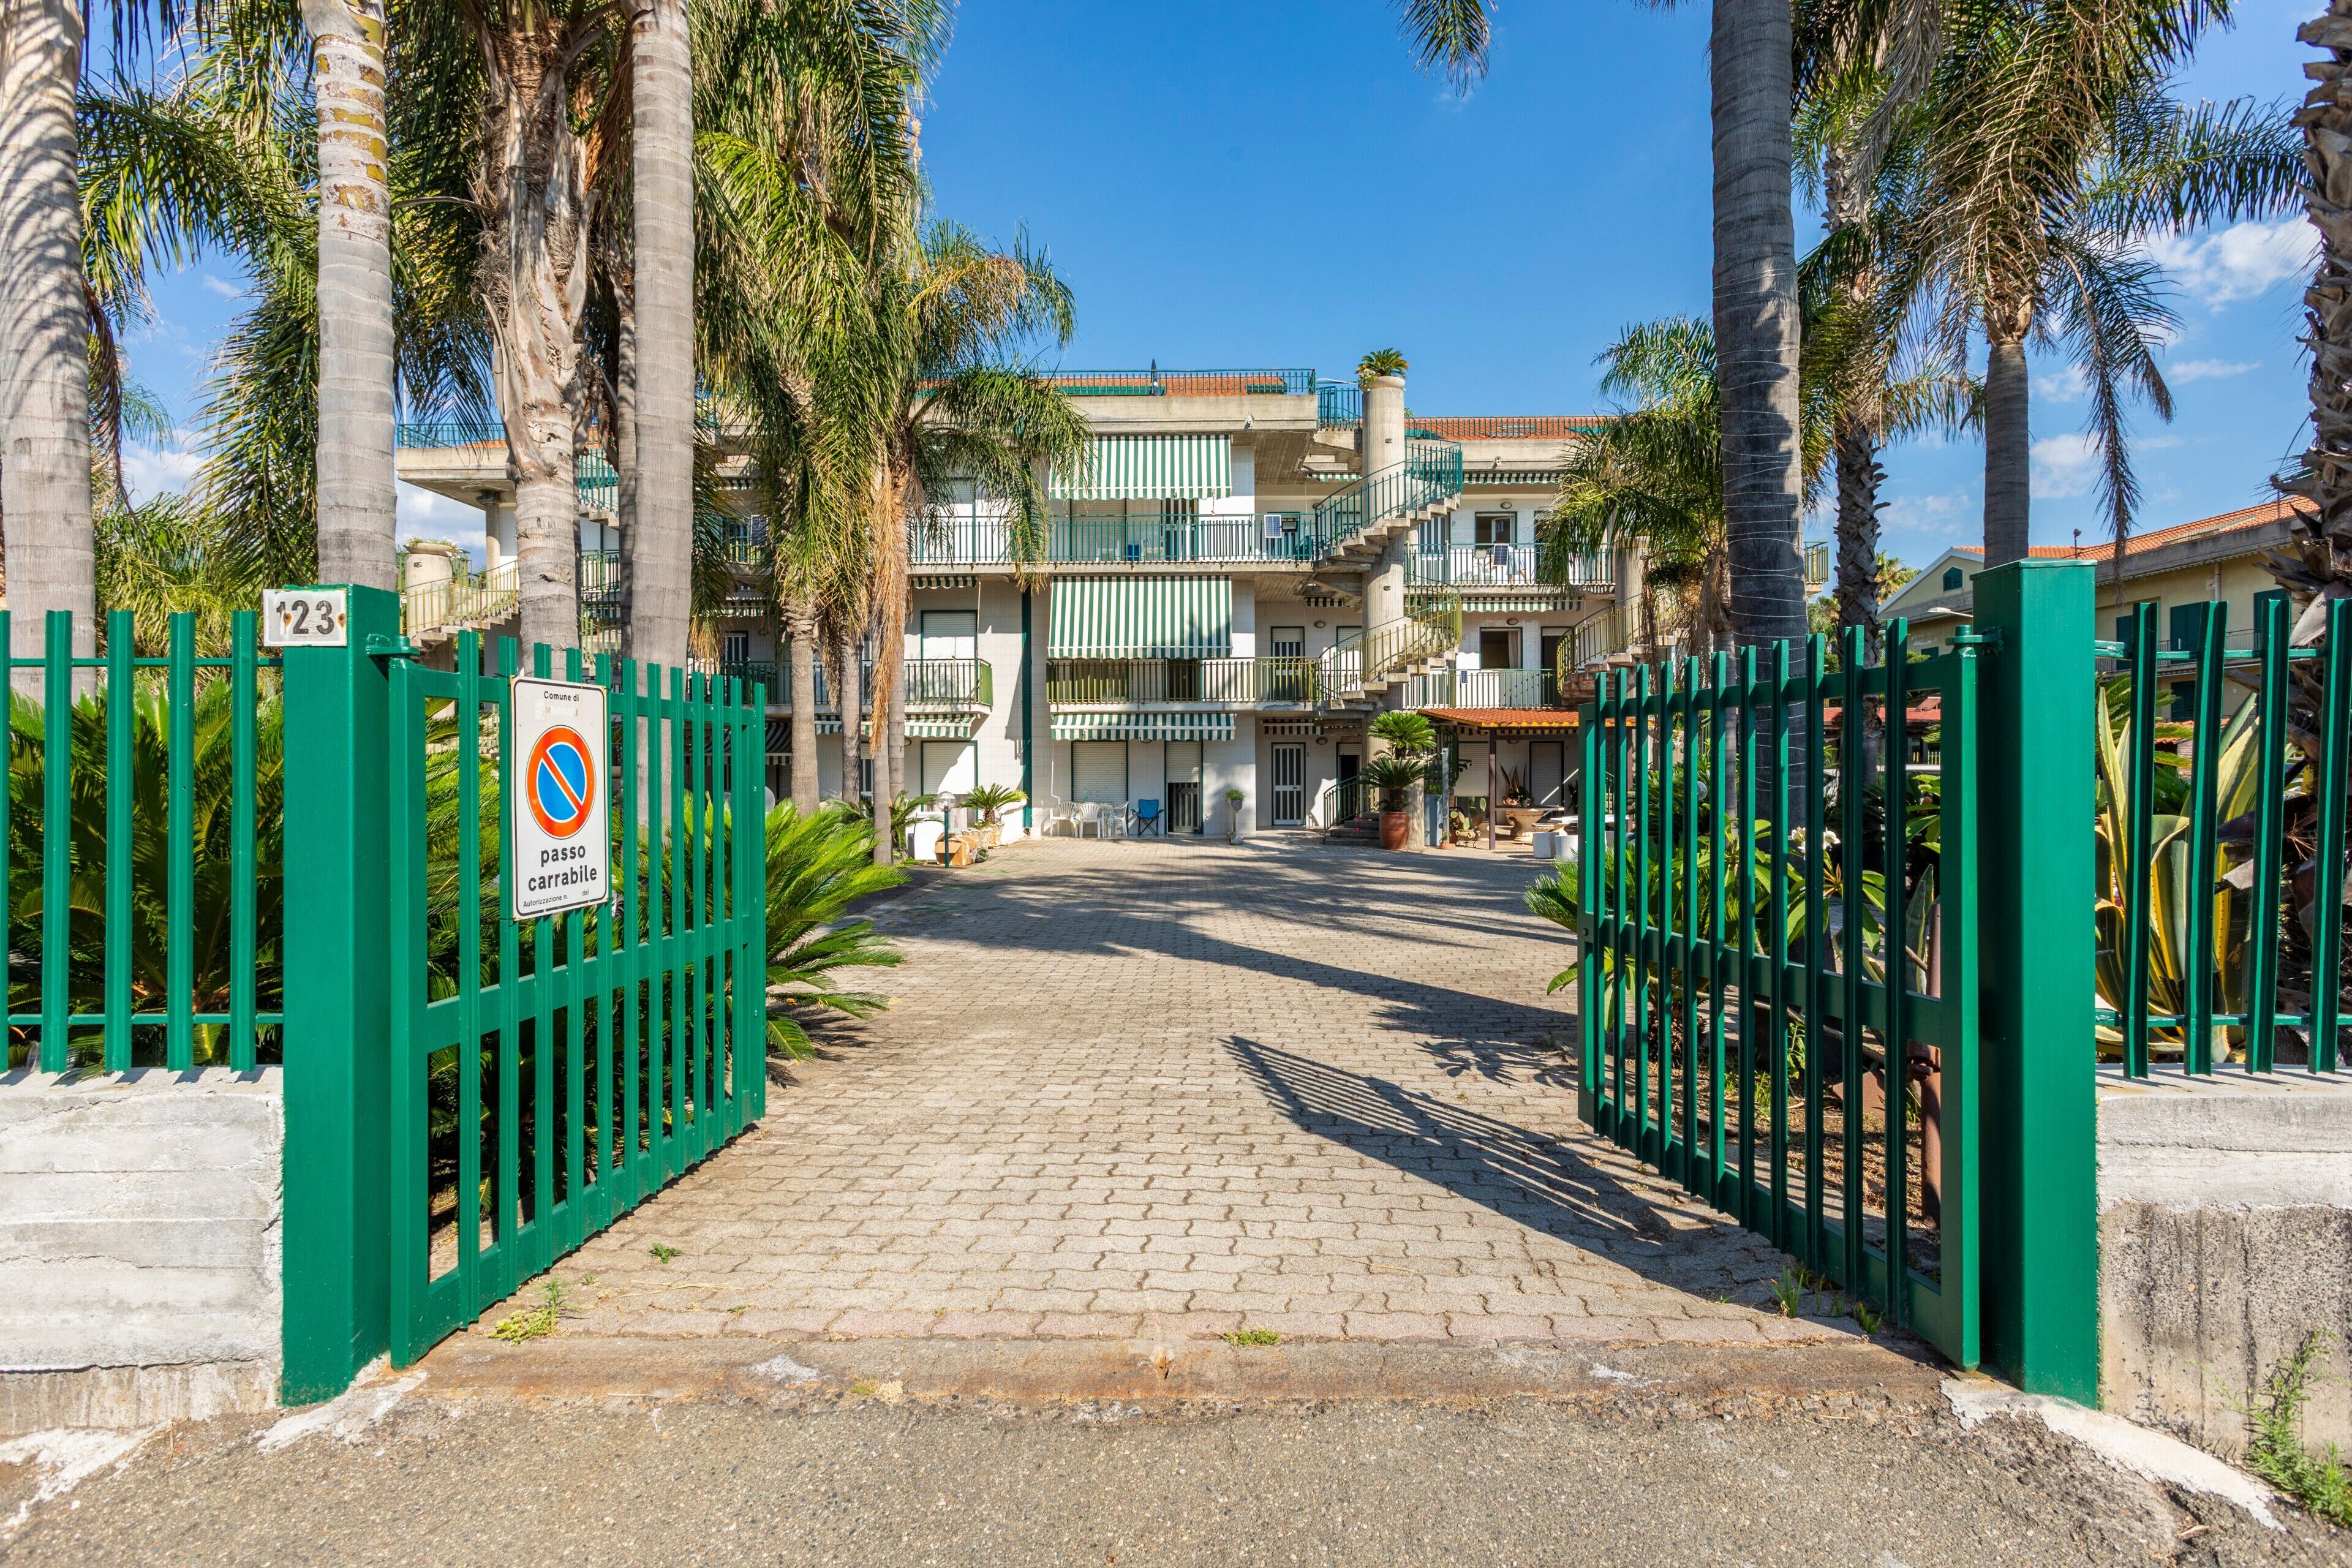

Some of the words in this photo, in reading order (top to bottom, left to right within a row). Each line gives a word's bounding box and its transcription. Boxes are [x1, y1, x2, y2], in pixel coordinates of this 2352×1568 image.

[276, 600, 334, 635] 123
[544, 690, 571, 701] Comune
[541, 845, 586, 867] passo
[528, 864, 597, 892] carrabile
[523, 895, 562, 908] Autorizzazione
